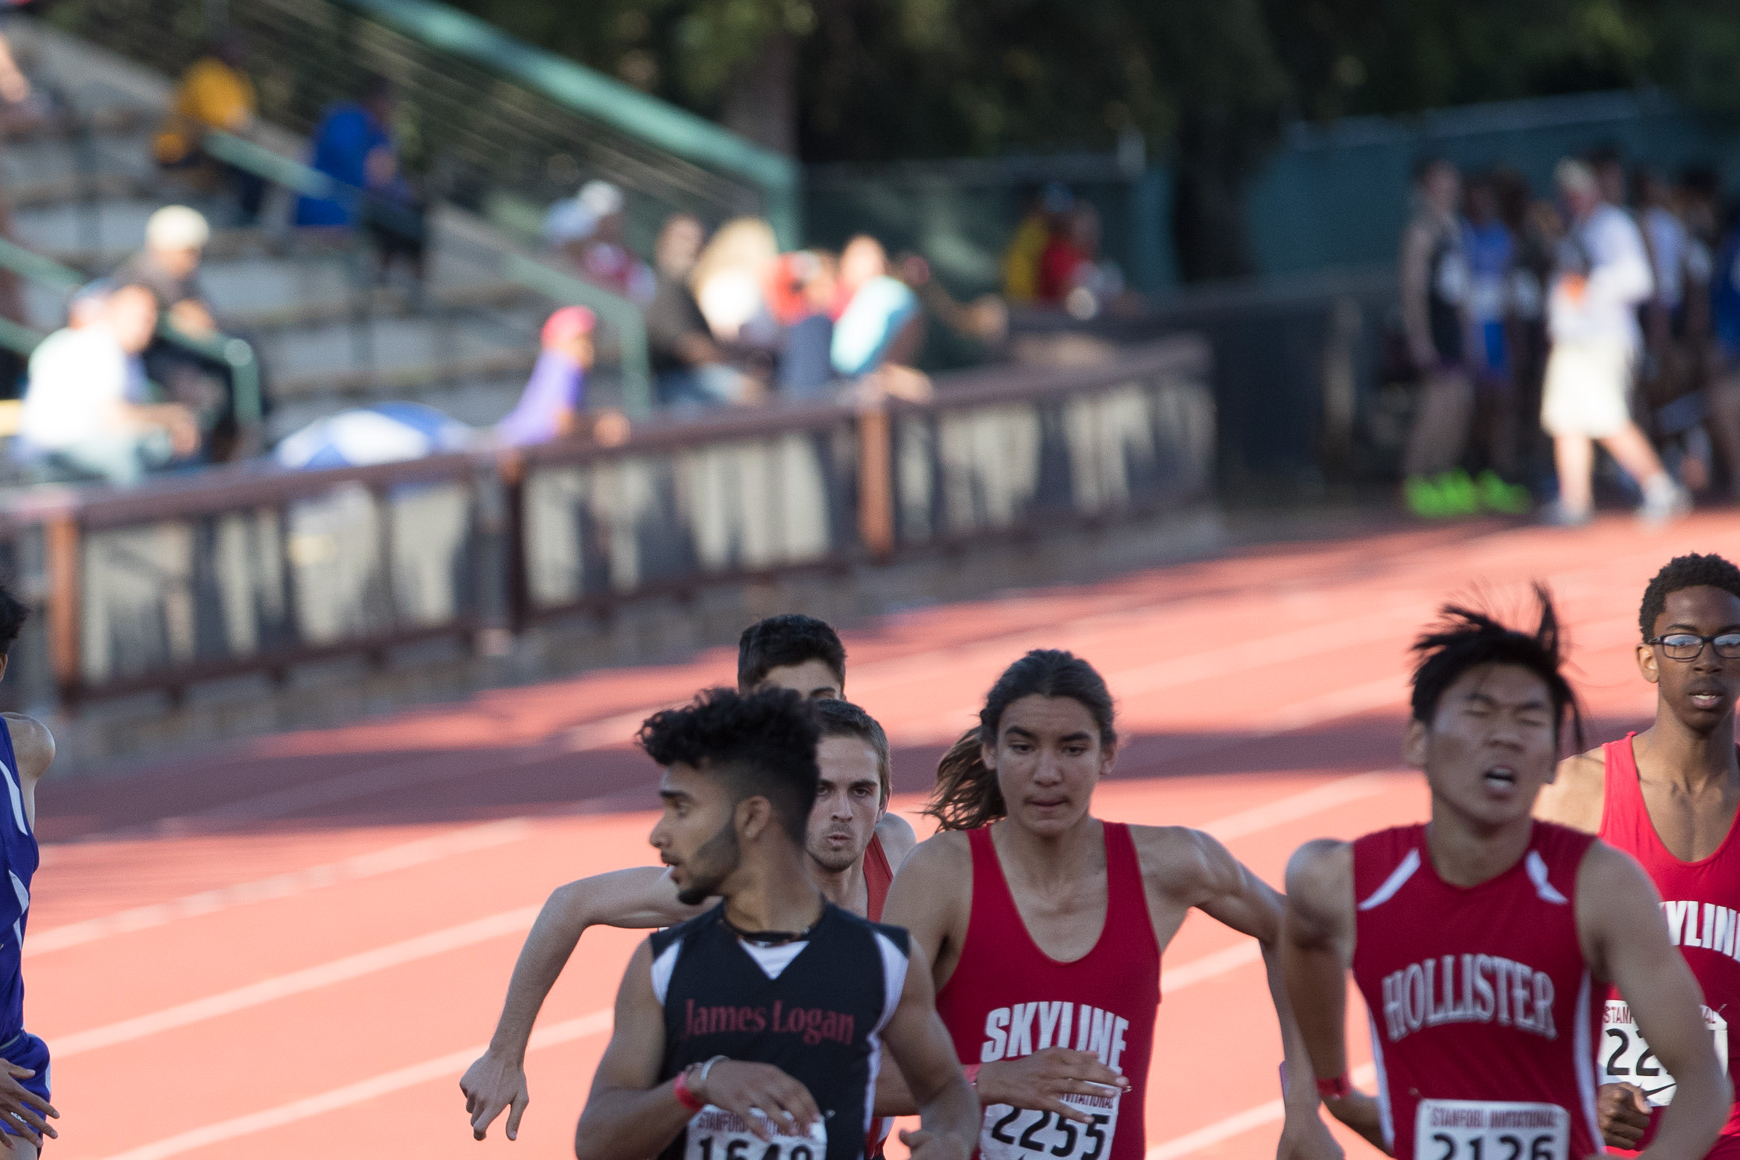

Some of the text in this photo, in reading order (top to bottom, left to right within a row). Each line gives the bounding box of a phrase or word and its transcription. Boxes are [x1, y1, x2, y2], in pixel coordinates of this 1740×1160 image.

[1658, 900, 1740, 962] YLIN
[680, 999, 855, 1045] James Logan
[1382, 953, 1558, 1041] HOLLISTER
[1603, 1006, 1632, 1024] STAN
[980, 1001, 1129, 1074] SKYLINE
[1606, 1028, 1660, 1077] 22
